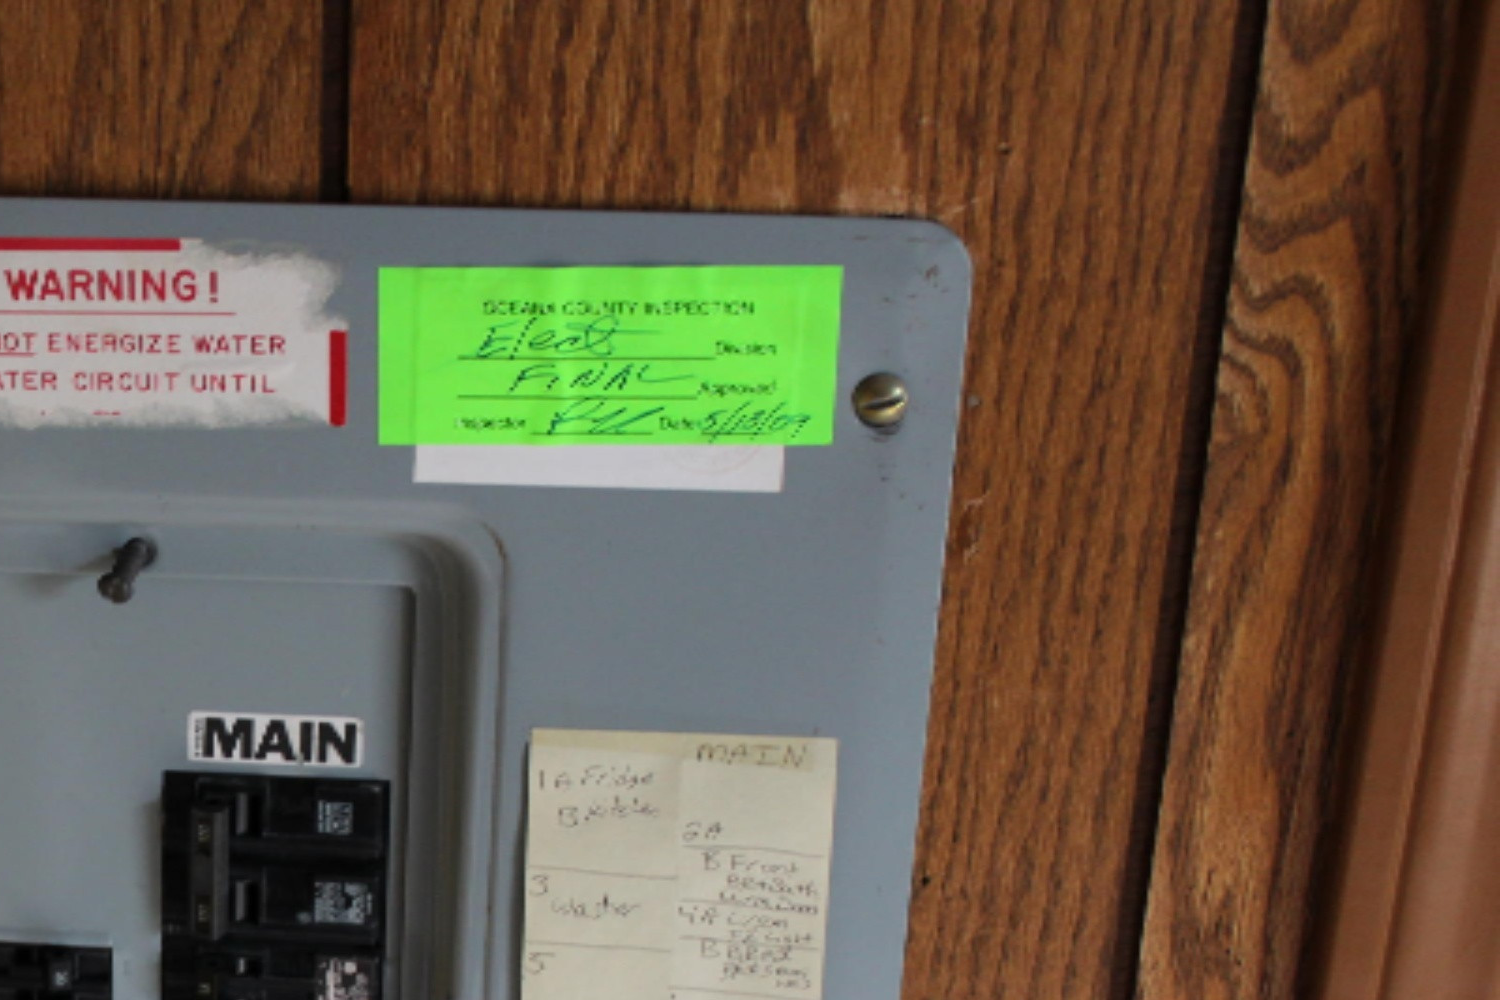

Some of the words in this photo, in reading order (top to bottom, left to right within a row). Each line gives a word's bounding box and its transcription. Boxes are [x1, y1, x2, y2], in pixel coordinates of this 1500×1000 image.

[4, 268, 219, 303] WARNING!
[483, 301, 555, 316] OCEAN
[562, 301, 637, 316] COUNTY
[644, 300, 755, 316] INSPECTION
[47, 333, 181, 354] ENERGIZE
[192, 335, 286, 355] WATER
[73, 371, 179, 392] CIRCUIT
[190, 373, 276, 393] UNTIL
[203, 716, 357, 764] MAIN
[528, 874, 548, 896] 3
